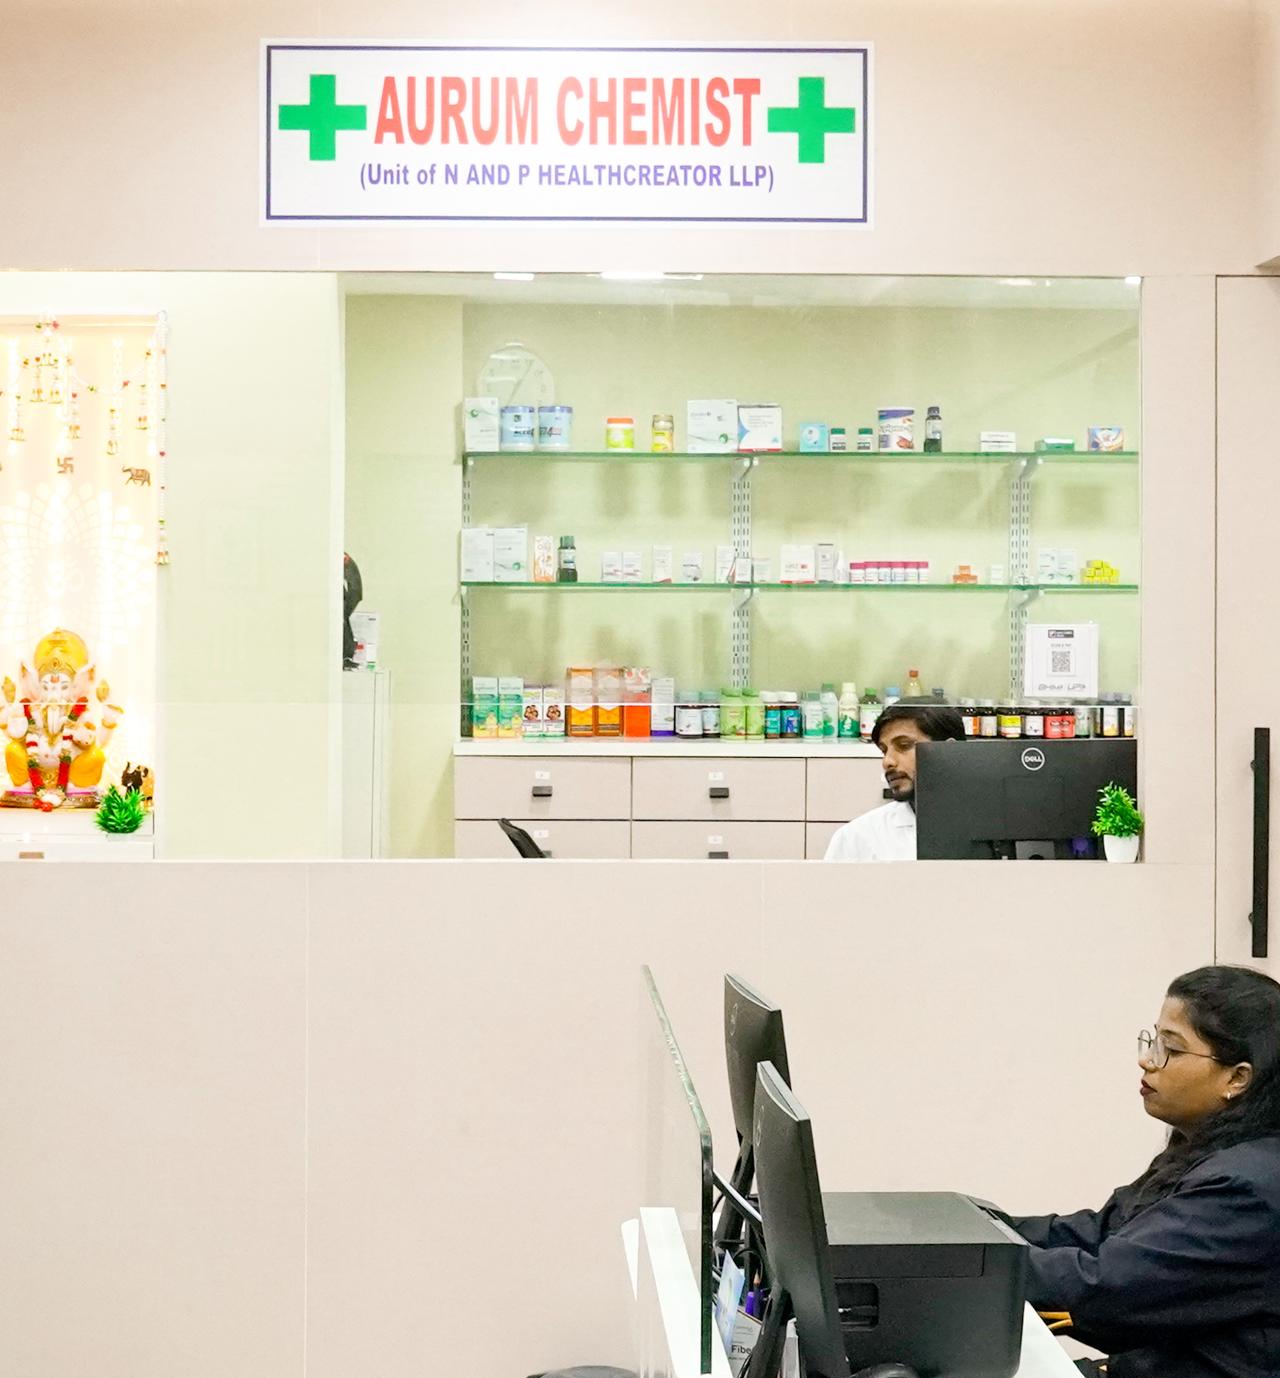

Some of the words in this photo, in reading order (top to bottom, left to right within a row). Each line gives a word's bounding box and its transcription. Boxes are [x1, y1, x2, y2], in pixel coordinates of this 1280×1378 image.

[374, 76, 539, 146] AURUM
[556, 76, 761, 147] CHEMIST
[360, 163, 410, 191] (Unit
[417, 163, 436, 187] of
[444, 164, 459, 186] N
[466, 164, 510, 187] AND
[518, 164, 530, 186] P
[538, 164, 721, 187] HEALTHCREATOR
[729, 165, 775, 192] LLP)
[1024, 755, 1042, 763] DELL
